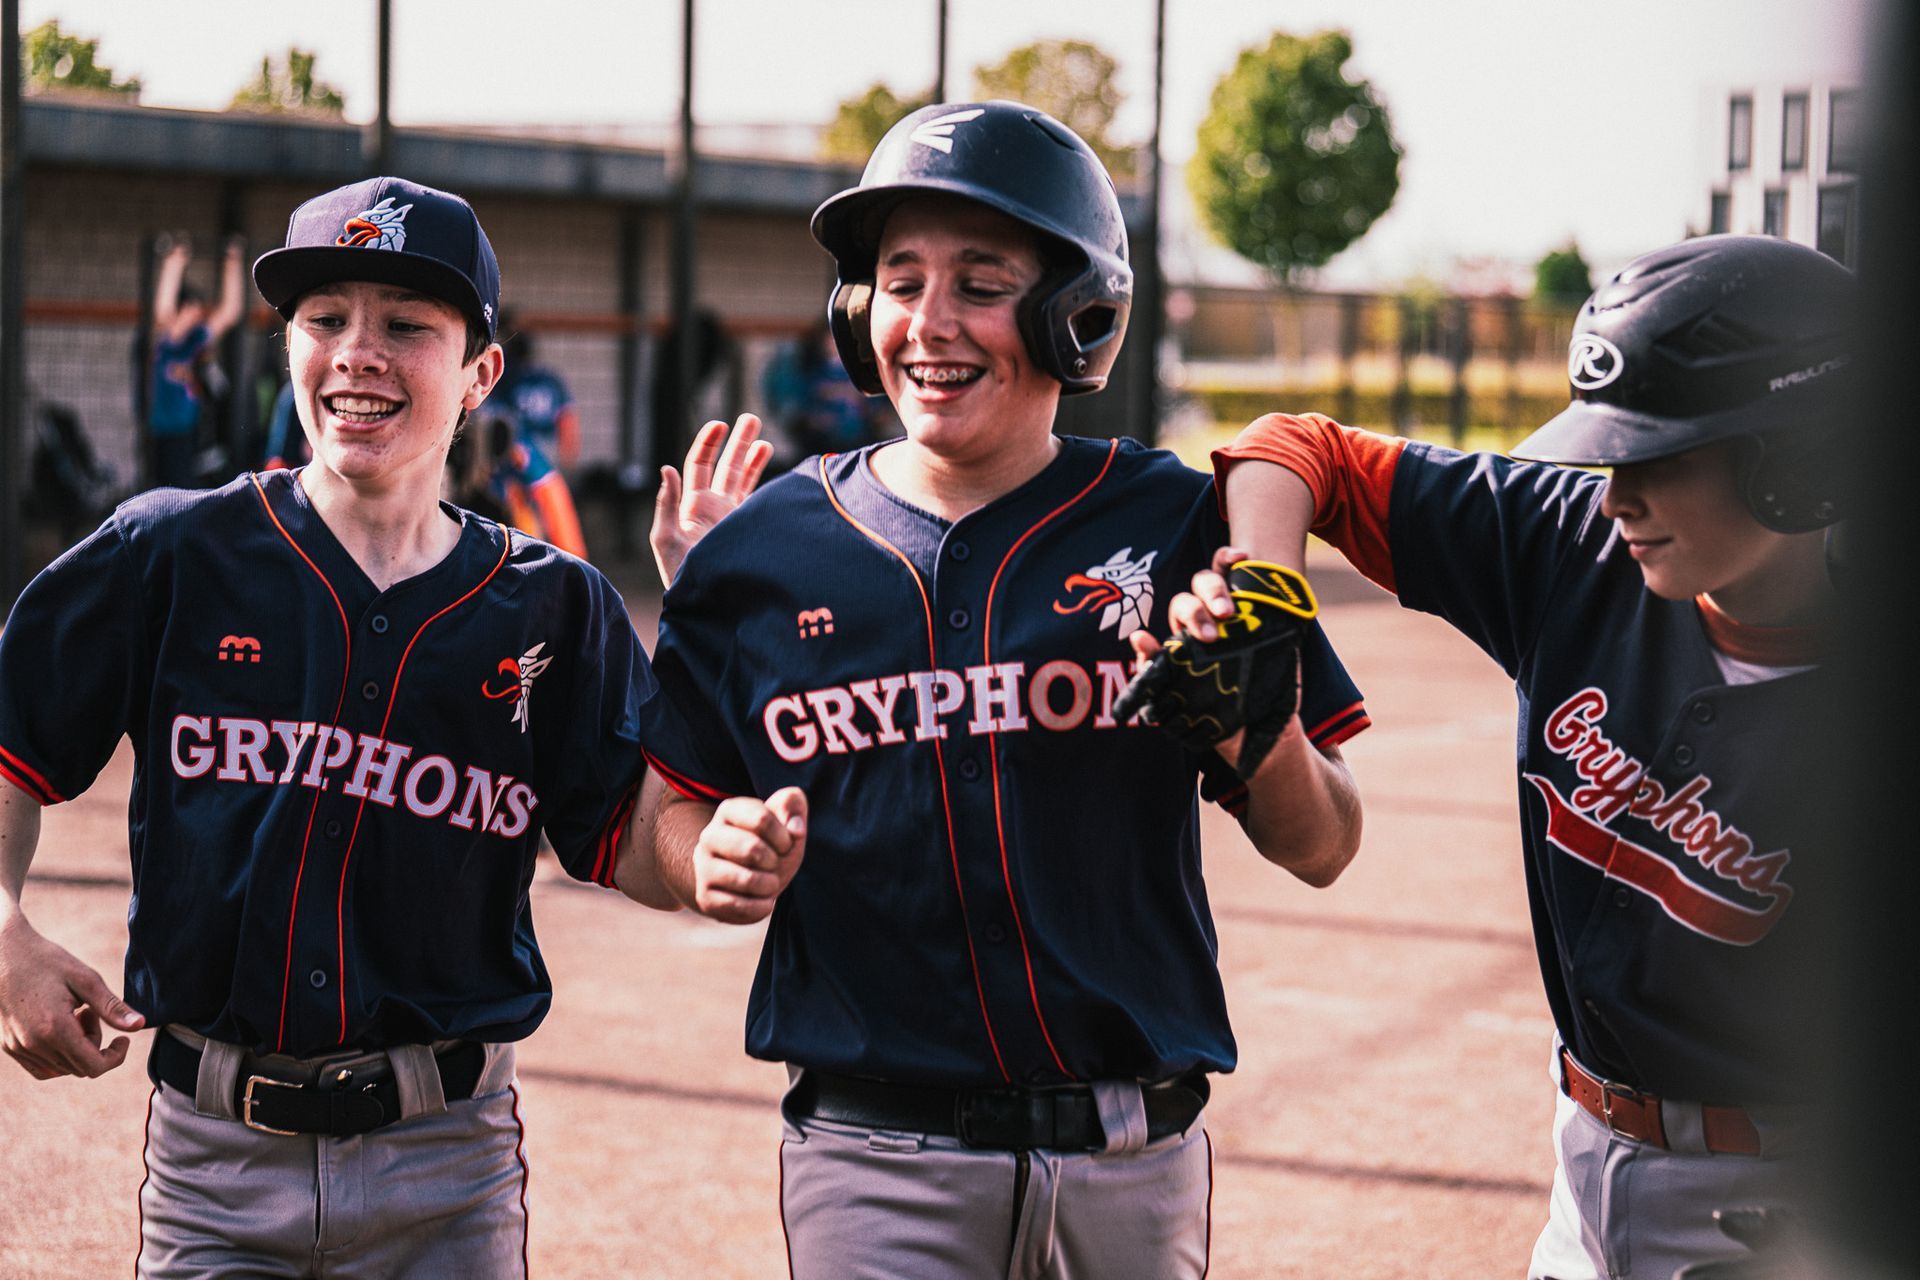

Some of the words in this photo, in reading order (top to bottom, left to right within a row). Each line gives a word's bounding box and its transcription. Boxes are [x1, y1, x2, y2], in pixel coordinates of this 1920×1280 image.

[763, 660, 1159, 763] GRYPHON
[170, 714, 539, 839] GRYPHONS
[1544, 686, 1791, 896] Gryphons
